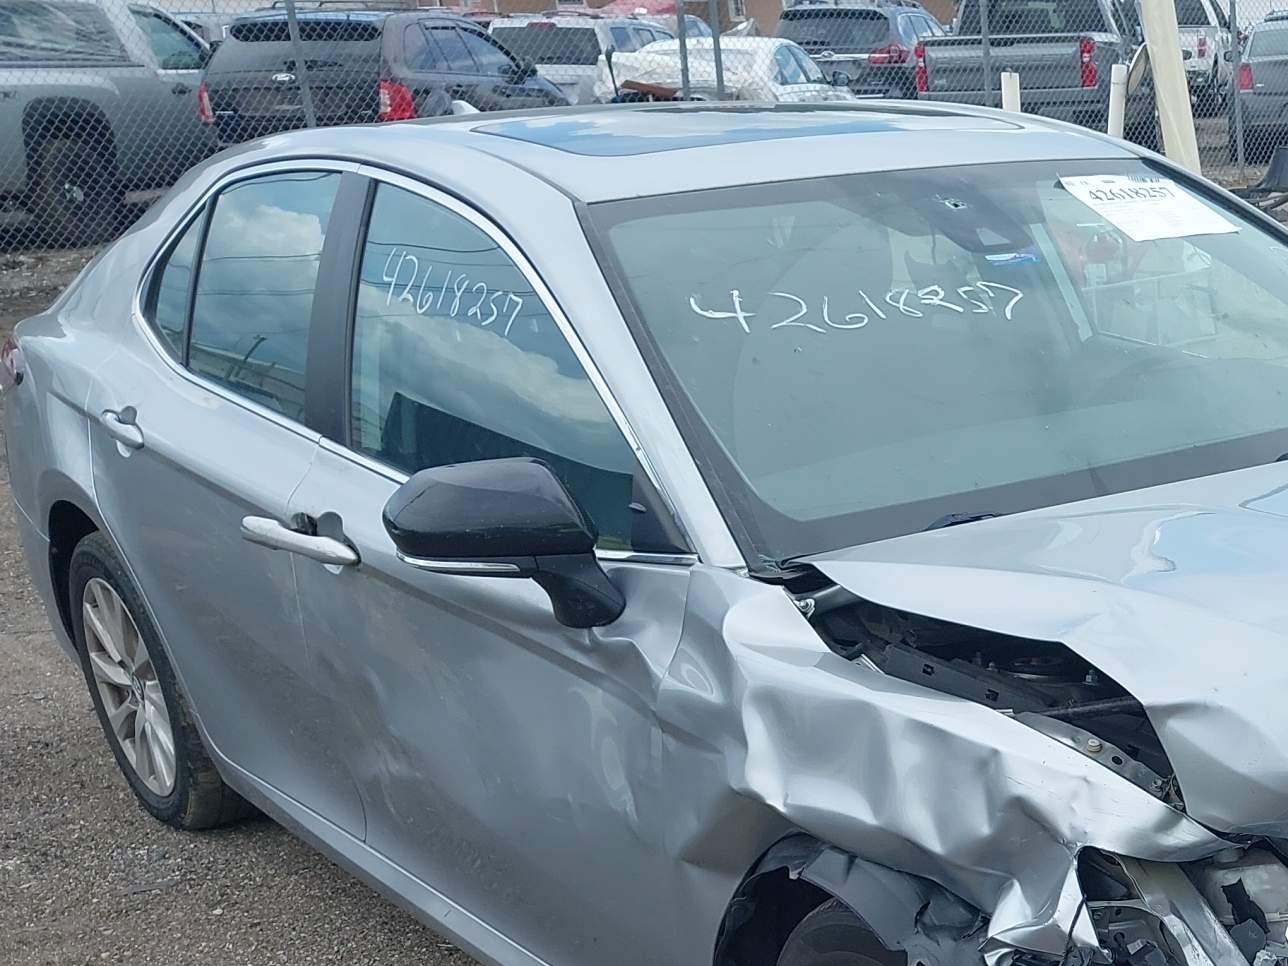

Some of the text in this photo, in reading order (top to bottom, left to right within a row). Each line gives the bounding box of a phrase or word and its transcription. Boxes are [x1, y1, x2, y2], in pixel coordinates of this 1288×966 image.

[1088, 186, 1176, 201] 42618257
[382, 247, 524, 337] 42618257
[689, 281, 1025, 334] 42618257
